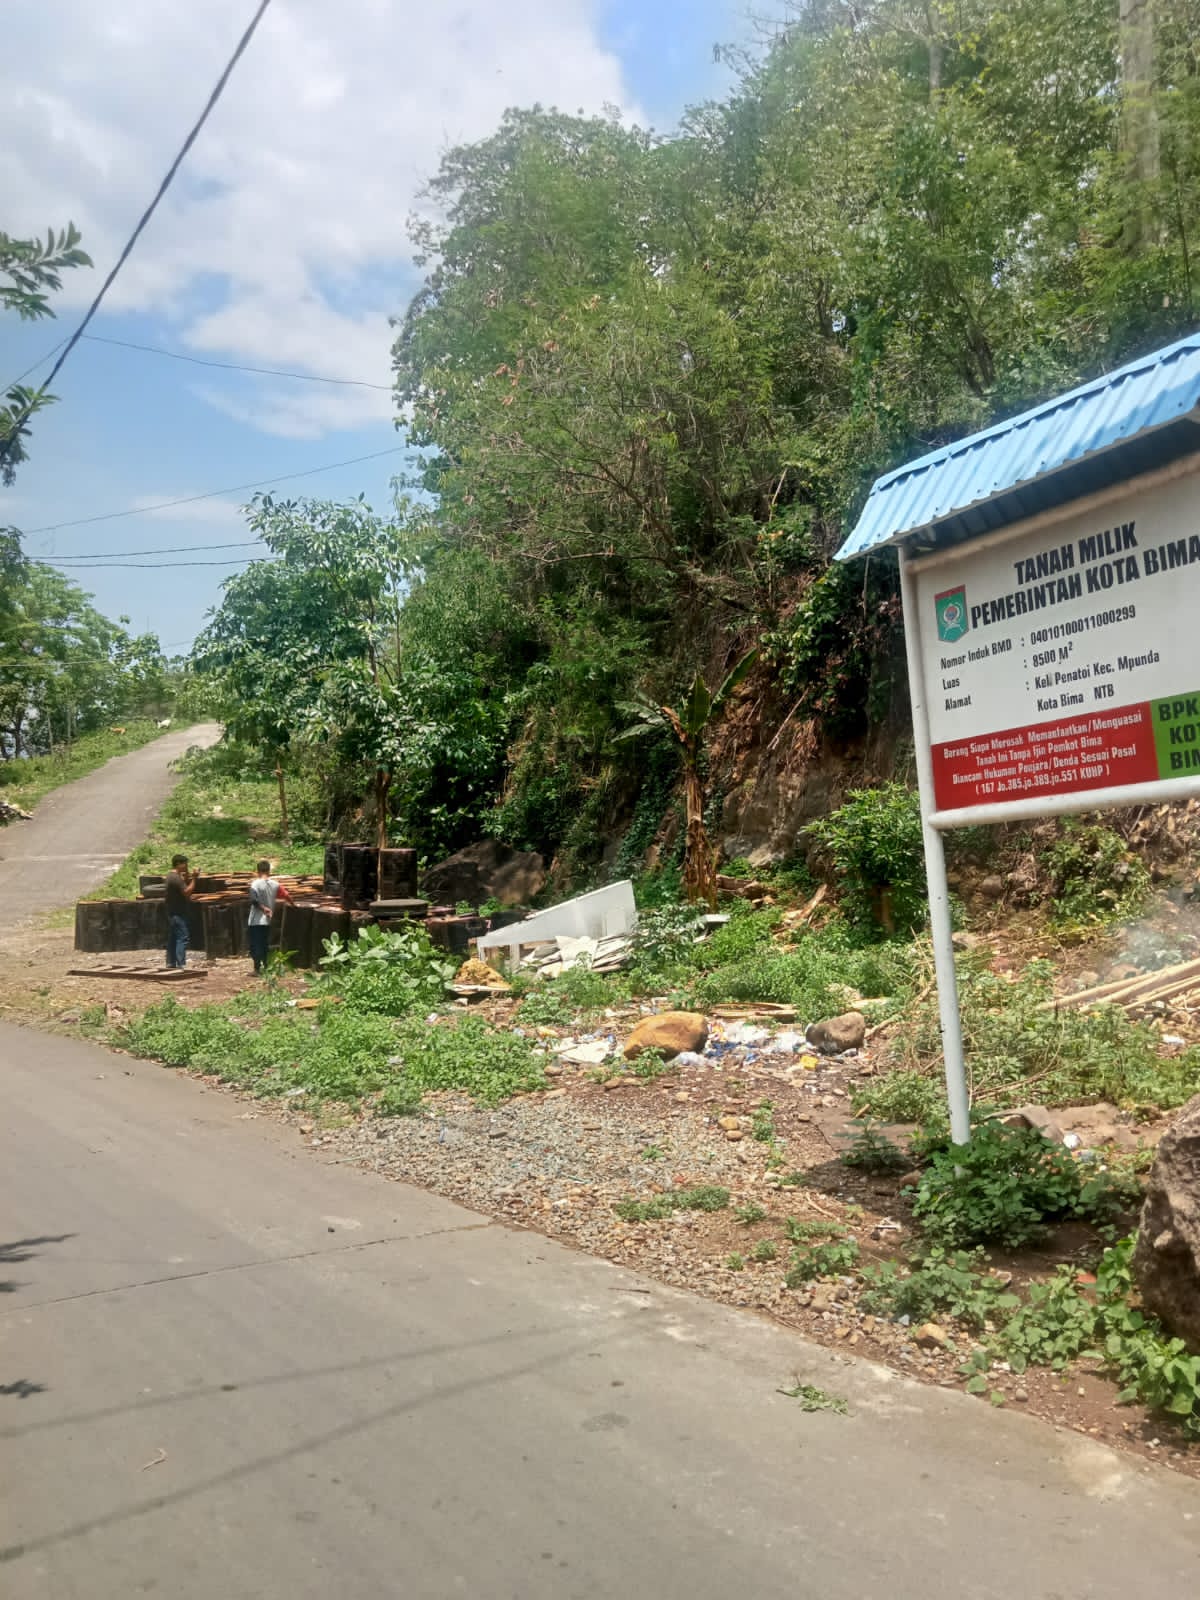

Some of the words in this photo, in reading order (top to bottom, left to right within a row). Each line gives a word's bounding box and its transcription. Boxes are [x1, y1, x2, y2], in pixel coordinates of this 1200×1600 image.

[1014, 544, 1075, 585] TANAH
[1078, 520, 1139, 564] MILIK
[970, 577, 1083, 629] PEMERINTAH
[1086, 555, 1141, 594] KOTA
[1143, 534, 1200, 577] BIMA
[940, 654, 967, 670] Nomor
[967, 644, 990, 662] Induk
[991, 638, 1012, 656] BMD
[942, 678, 960, 690] Luas
[1032, 648, 1057, 668] 8500
[945, 694, 972, 711] Alamat
[1054, 664, 1091, 686] Penatoi
[1093, 661, 1115, 677] Kec.
[1117, 649, 1160, 672] Mpunda
[1037, 697, 1059, 713] Kota
[1060, 691, 1085, 708] Bima
[1093, 682, 1115, 701] NTB
[976, 753, 997, 767] Tanah
[1048, 738, 1079, 754] Pemkot
[1081, 735, 1102, 749] Bima
[1111, 743, 1137, 759] Pasal
